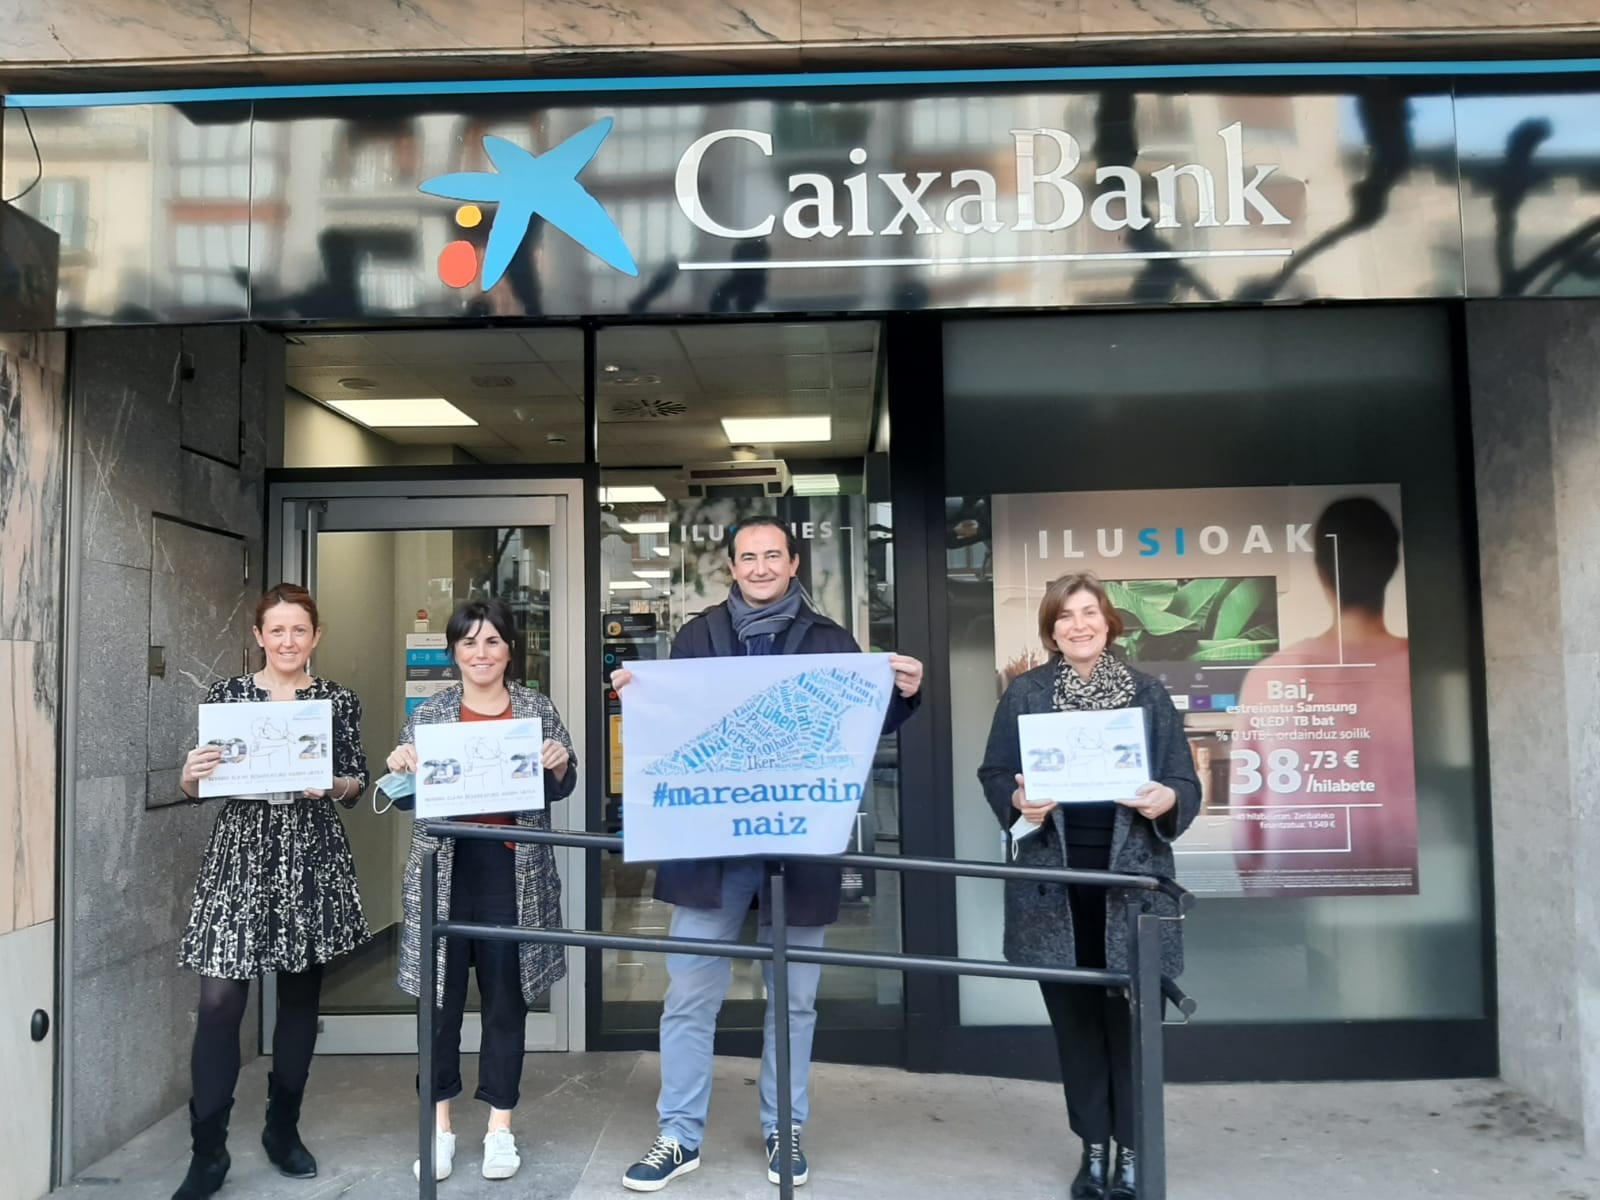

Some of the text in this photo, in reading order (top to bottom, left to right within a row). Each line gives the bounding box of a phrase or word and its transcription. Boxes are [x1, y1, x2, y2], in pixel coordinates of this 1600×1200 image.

[674, 121, 1292, 240] CaixaBank
[1038, 523, 1314, 559] ILUSIOAK
[1267, 679, 1315, 702] Bai,
[755, 694, 798, 735] Luken
[1226, 702, 1358, 715] estreinatu Samsung
[1293, 716, 1309, 727] TB
[1312, 715, 1335, 727] bat
[719, 716, 757, 753] Nerea
[1277, 729, 1337, 740] ordainduz
[1339, 728, 1370, 740] soilik
[422, 752, 539, 785] 20 21
[747, 754, 776, 770] Iker
[1230, 748, 1302, 794] 38
[652, 777, 864, 808] #mareaurdin
[1306, 774, 1375, 793] /hilabete
[732, 811, 808, 837] naiz
